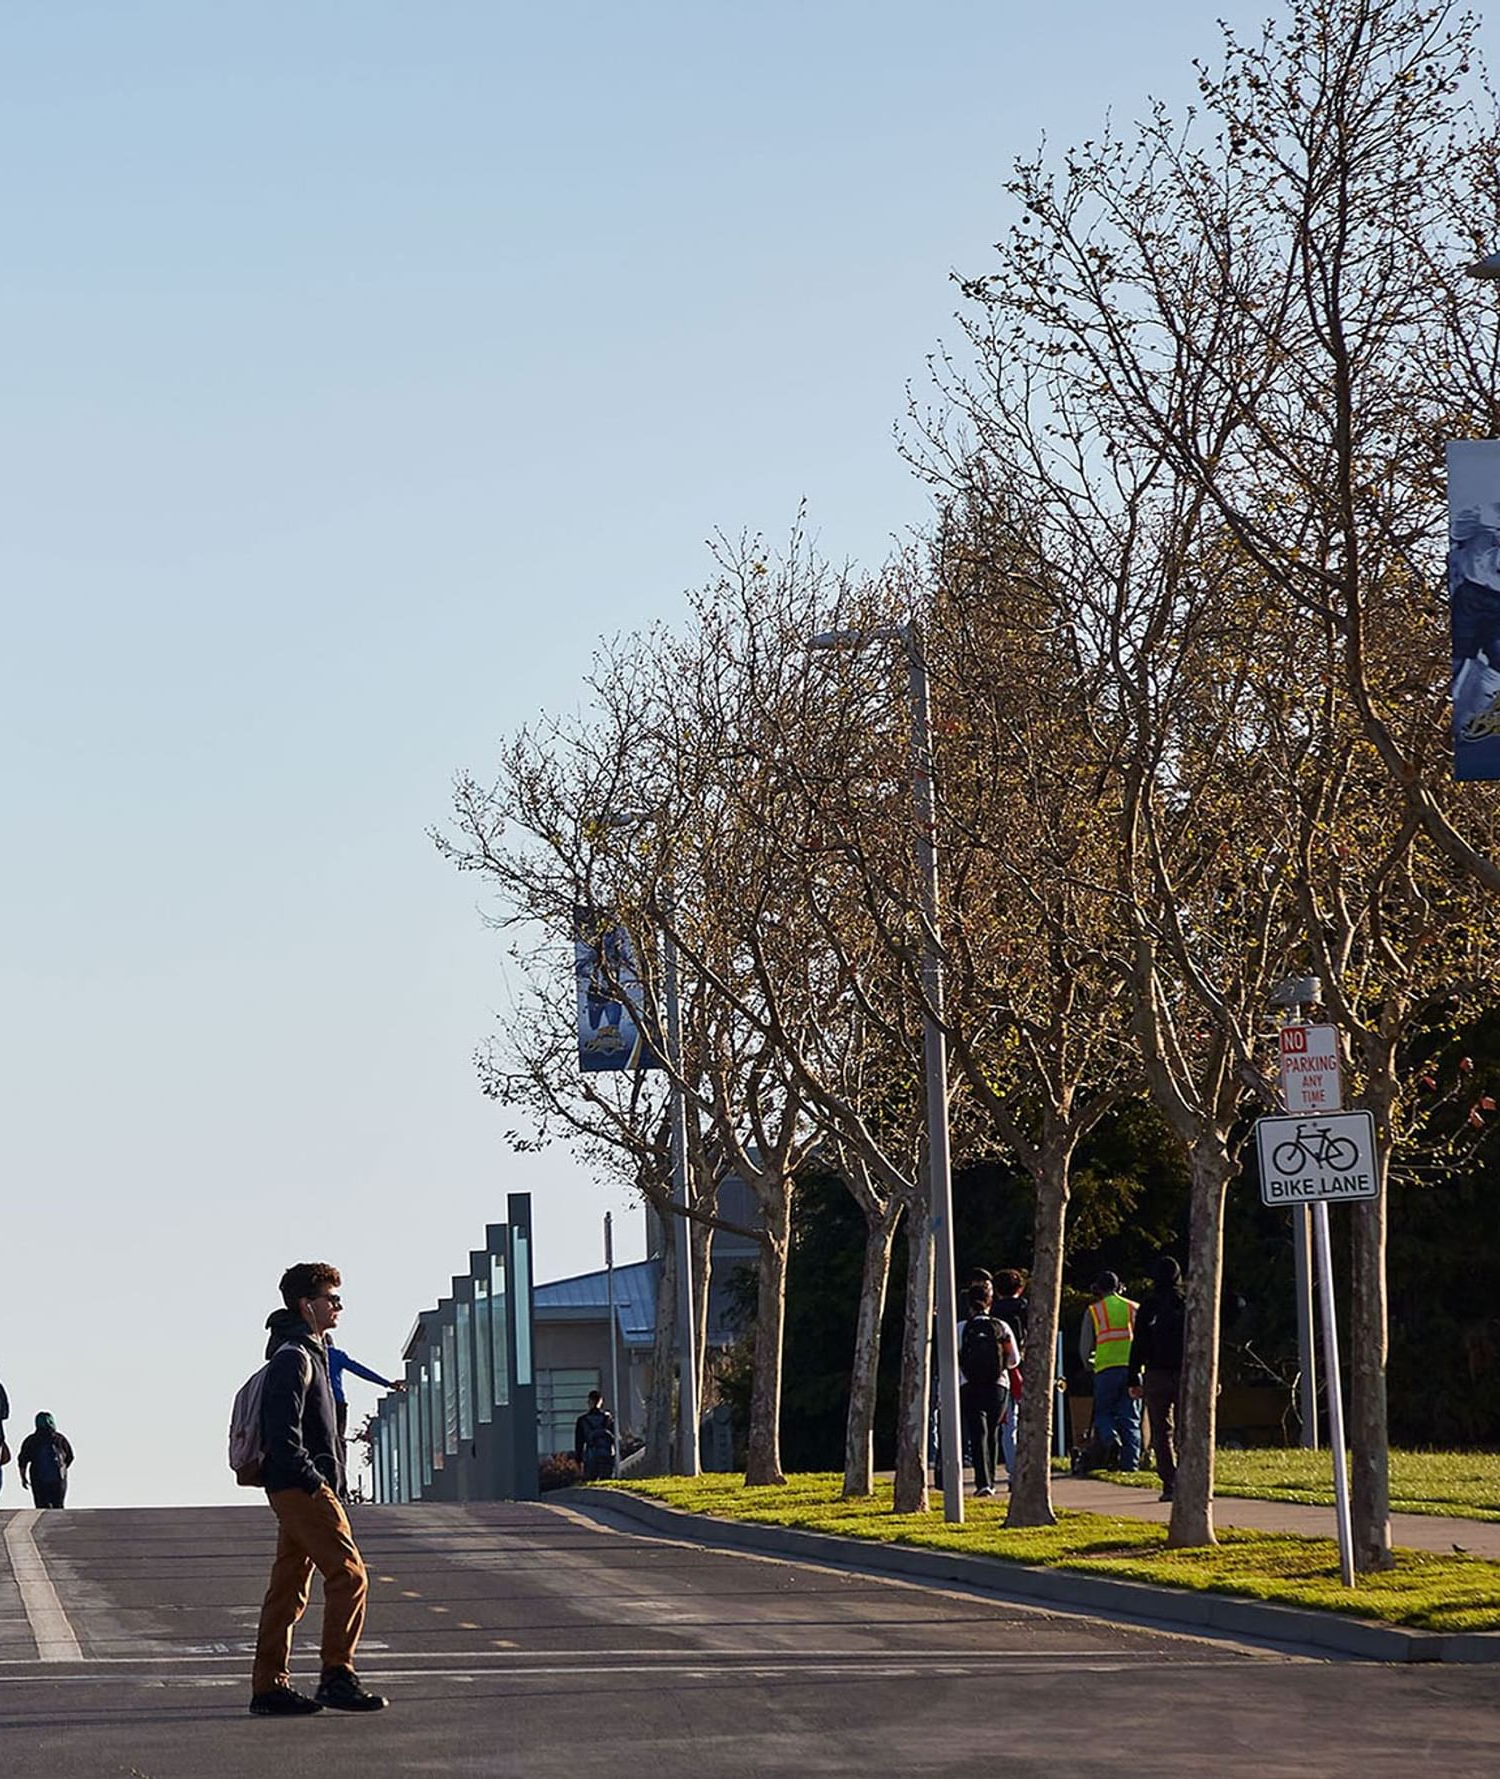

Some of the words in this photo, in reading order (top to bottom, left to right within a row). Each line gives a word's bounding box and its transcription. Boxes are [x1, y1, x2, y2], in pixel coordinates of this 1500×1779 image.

[1283, 1031, 1303, 1050] NO
[1286, 1055, 1336, 1073] PARKING
[1302, 1074, 1322, 1087] ANY
[1302, 1089, 1325, 1103] TIME
[1271, 1179, 1315, 1197] BIKE
[1320, 1175, 1369, 1194] LANE
